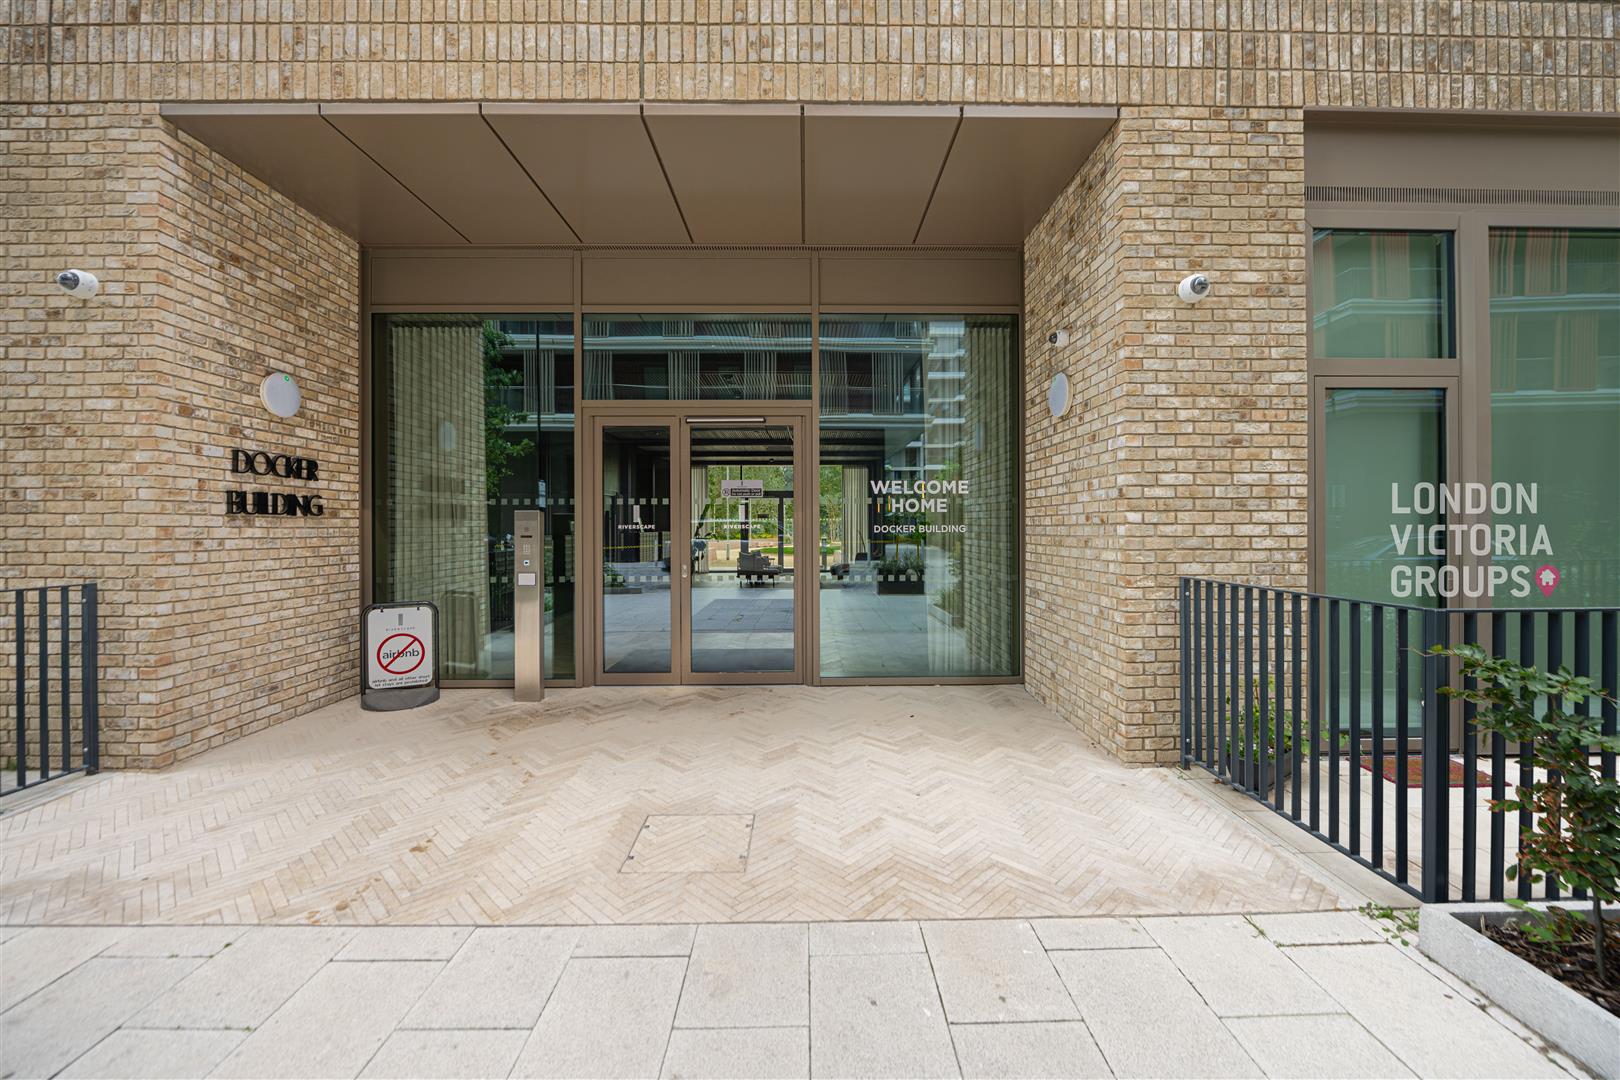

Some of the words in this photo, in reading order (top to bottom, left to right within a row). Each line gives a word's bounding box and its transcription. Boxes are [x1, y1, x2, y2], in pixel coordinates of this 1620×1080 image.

[231, 449, 319, 482] DOCKER
[870, 480, 969, 495] WELCOME
[226, 490, 324, 517] BUILDING
[891, 498, 948, 513] HOME
[873, 524, 916, 533] DOCKER
[918, 524, 967, 533] BUILDING
[382, 648, 420, 660] airbnb
